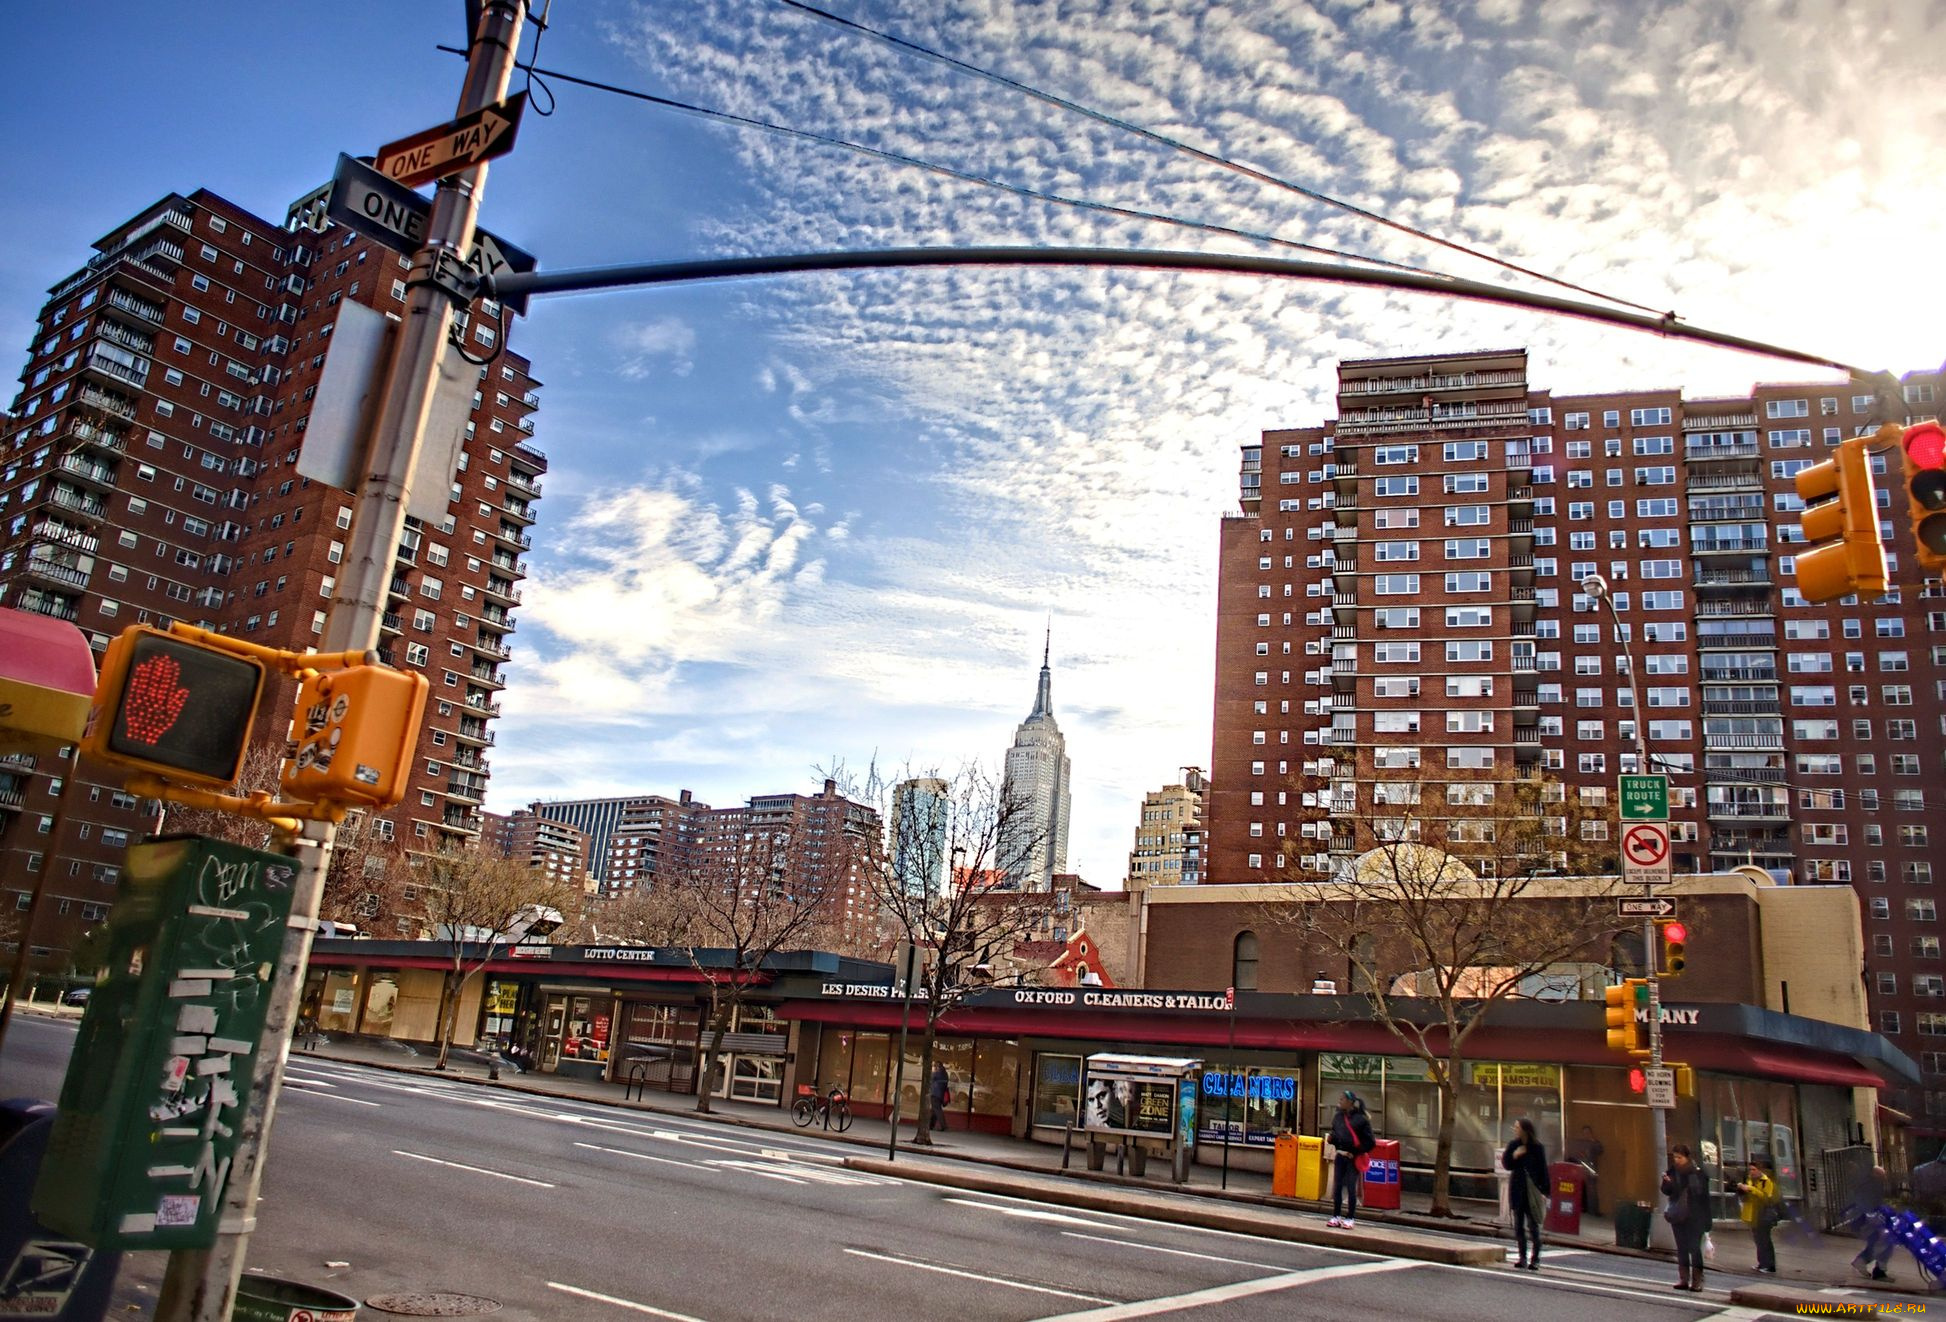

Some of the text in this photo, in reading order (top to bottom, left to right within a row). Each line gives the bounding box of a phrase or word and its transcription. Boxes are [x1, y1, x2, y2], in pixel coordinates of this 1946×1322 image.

[392, 119, 498, 177] ONE WAY
[363, 192, 425, 241] ONE
[1626, 779, 1661, 790] TRUCK
[1626, 791, 1661, 801] ROUTE
[1626, 903, 1667, 911] ONE WAY
[584, 948, 655, 961] LOTTO CENTER
[821, 983, 843, 995] LES
[845, 984, 889, 998] DESIRS
[1015, 990, 1075, 1004] OXFORD
[1632, 1008, 1699, 1025] MANY
[1203, 1072, 1294, 1100] CLEANERS
[1140, 1097, 1169, 1107] GREEN
[1140, 1106, 1169, 1117] ZONE
